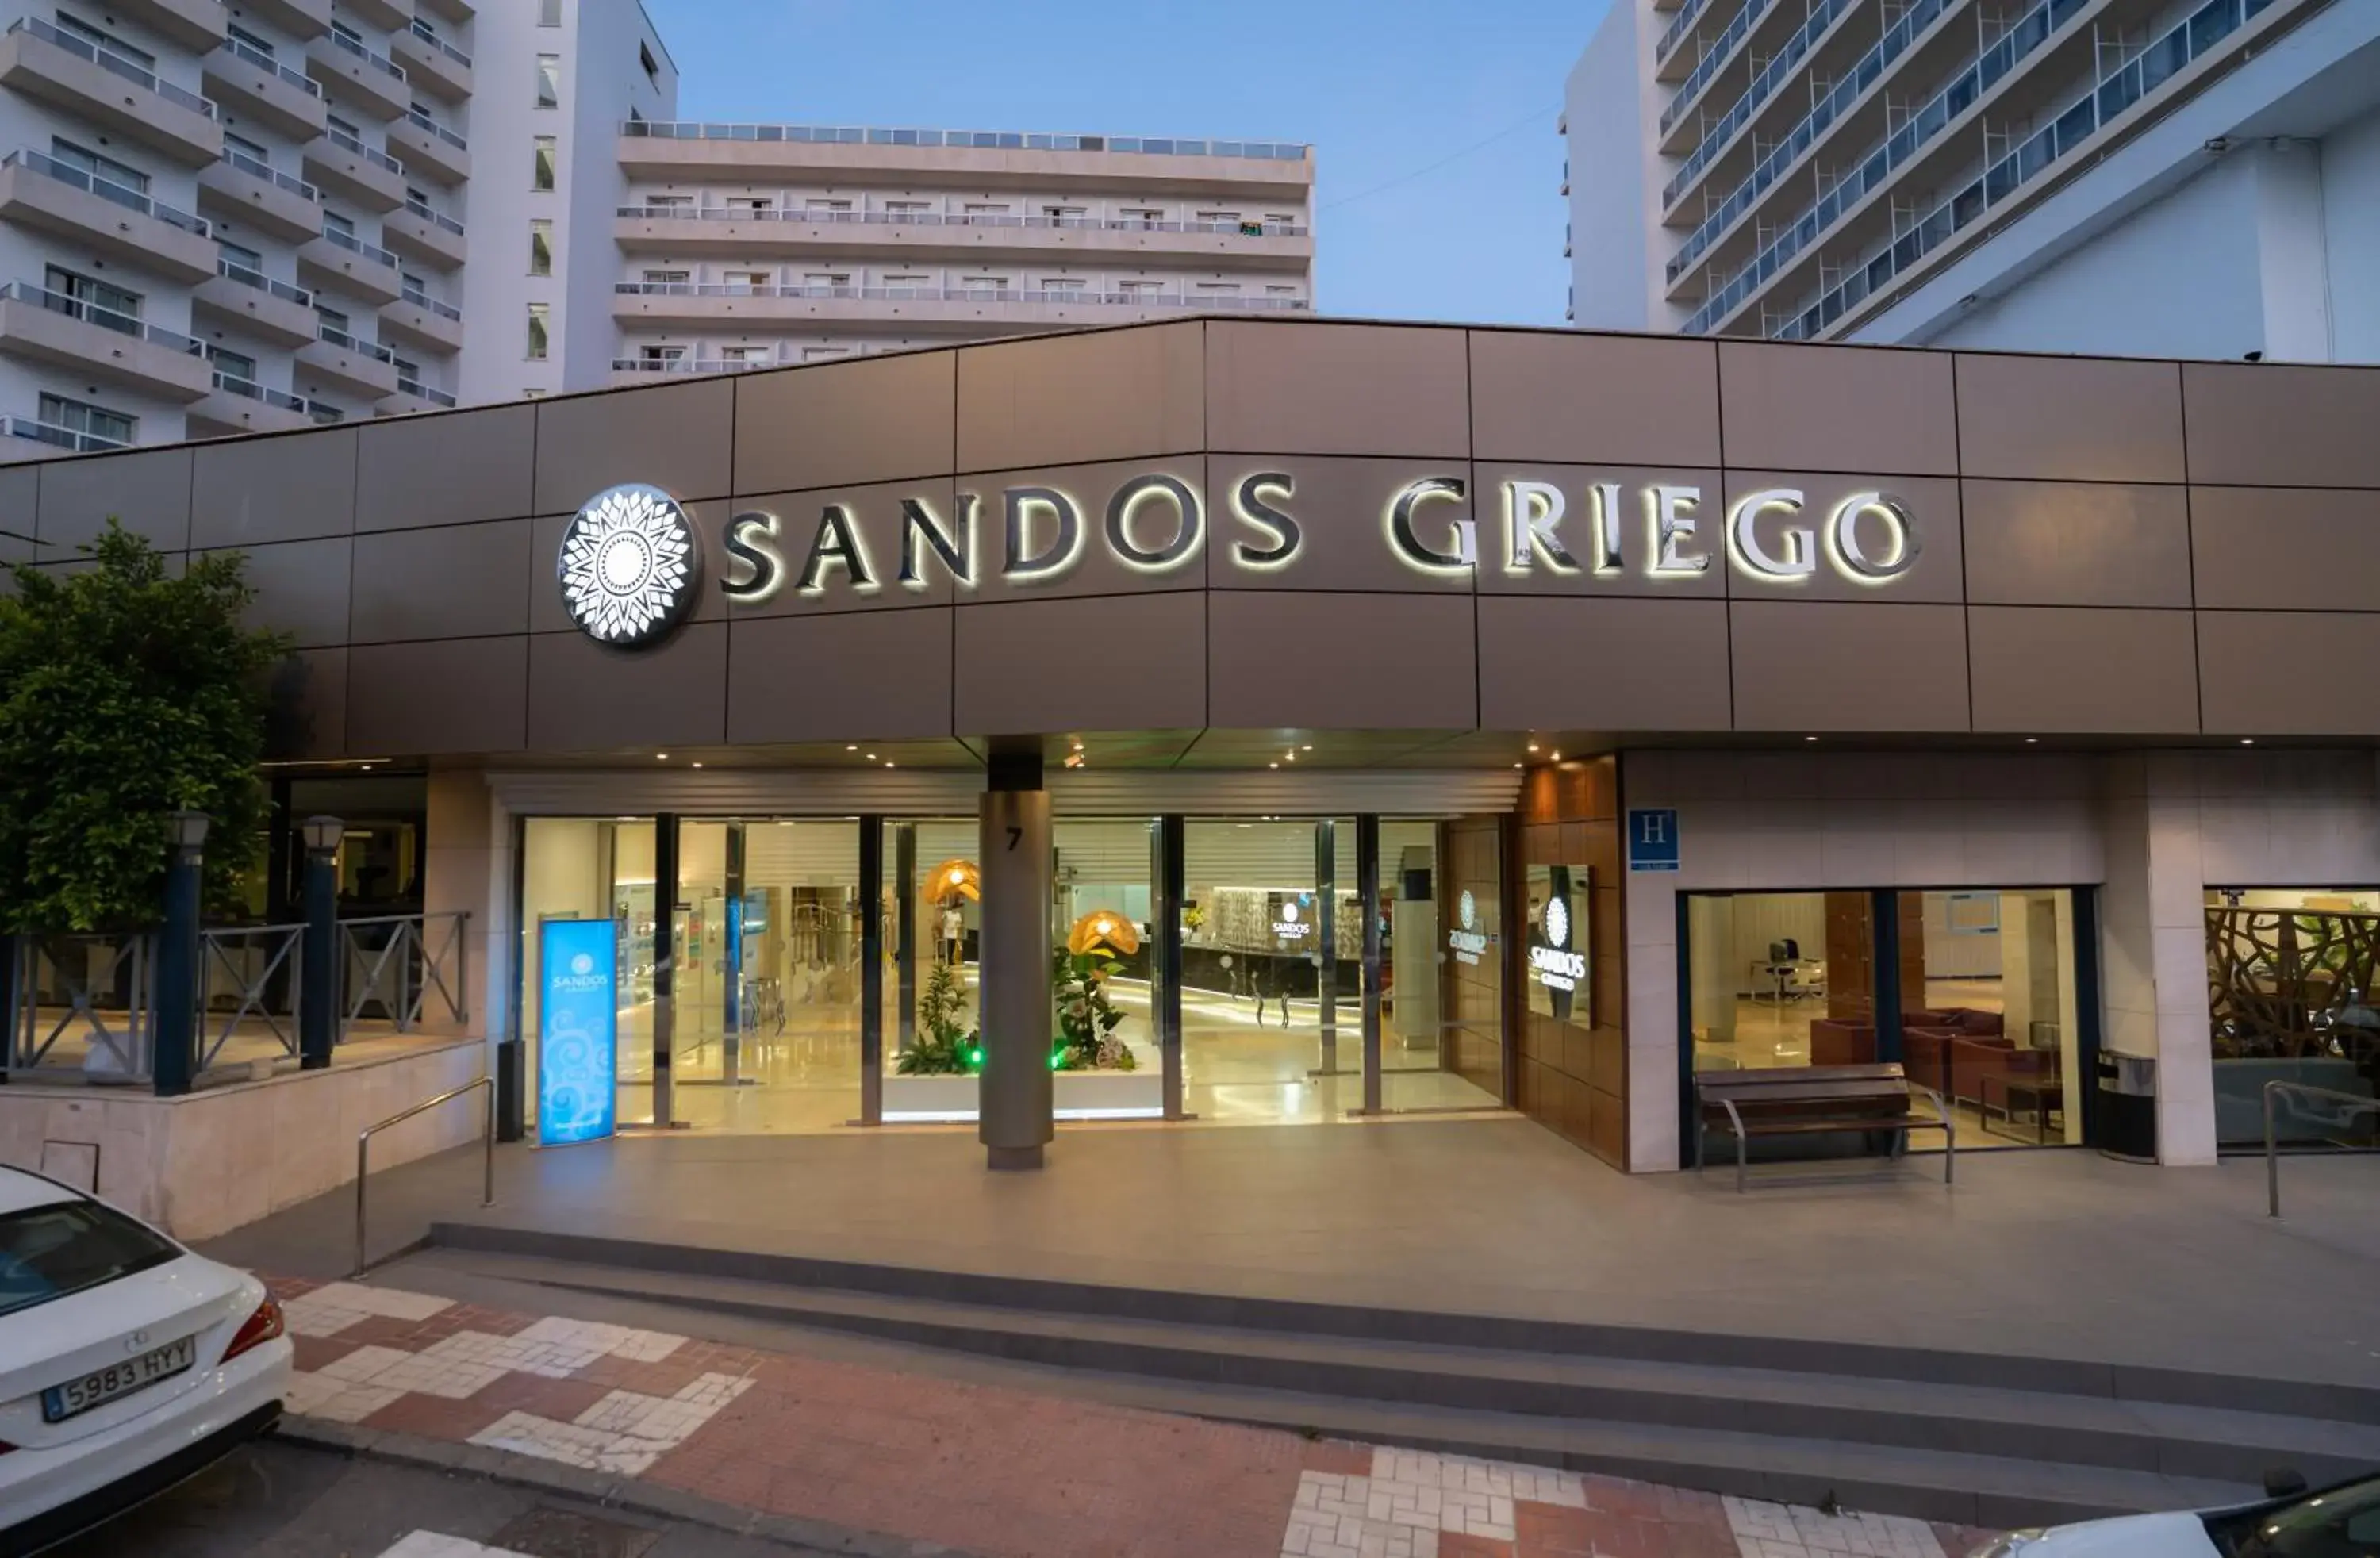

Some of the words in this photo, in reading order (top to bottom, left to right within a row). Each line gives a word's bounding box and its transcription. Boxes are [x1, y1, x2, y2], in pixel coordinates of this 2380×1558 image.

[720, 471, 1302, 601] SANDOS
[1385, 476, 1924, 581] GRIEGO
[1006, 827, 1023, 850] 7
[1641, 815, 1667, 843] H
[67, 1363, 136, 1406] 5983
[144, 1341, 188, 1377] HYY
